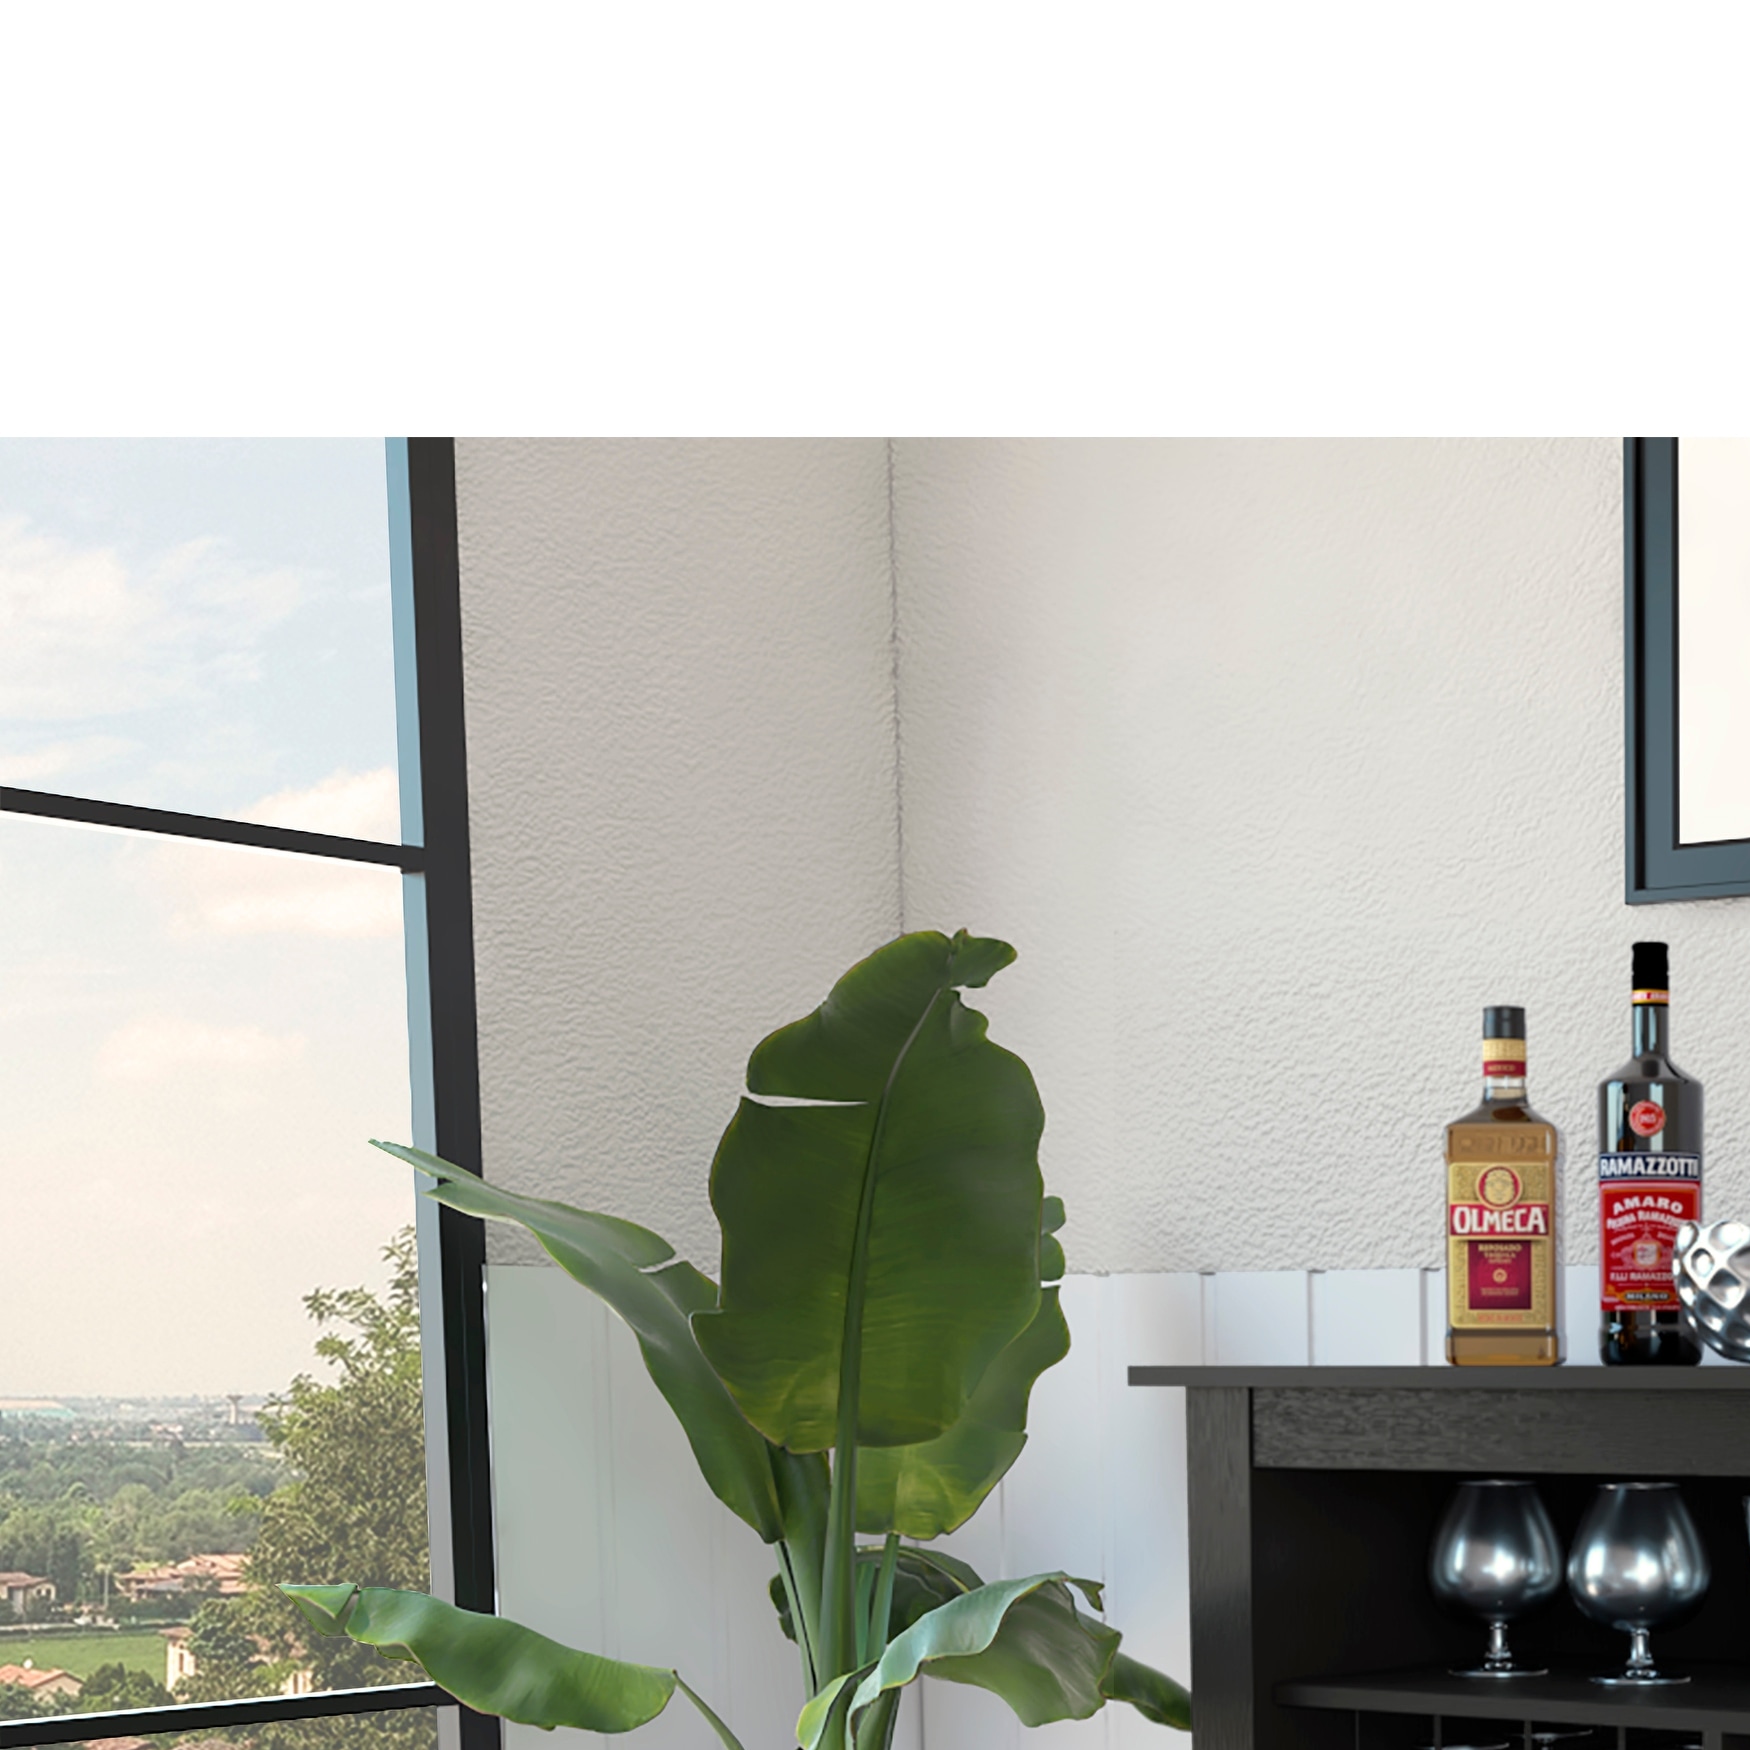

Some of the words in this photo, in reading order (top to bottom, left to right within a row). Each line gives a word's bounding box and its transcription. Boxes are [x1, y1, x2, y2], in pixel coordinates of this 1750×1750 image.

[1600, 1156, 1699, 1177] RAMAZZOTTI
[1613, 1195, 1684, 1217] AMARO
[1453, 1206, 1547, 1234] OLMECA
